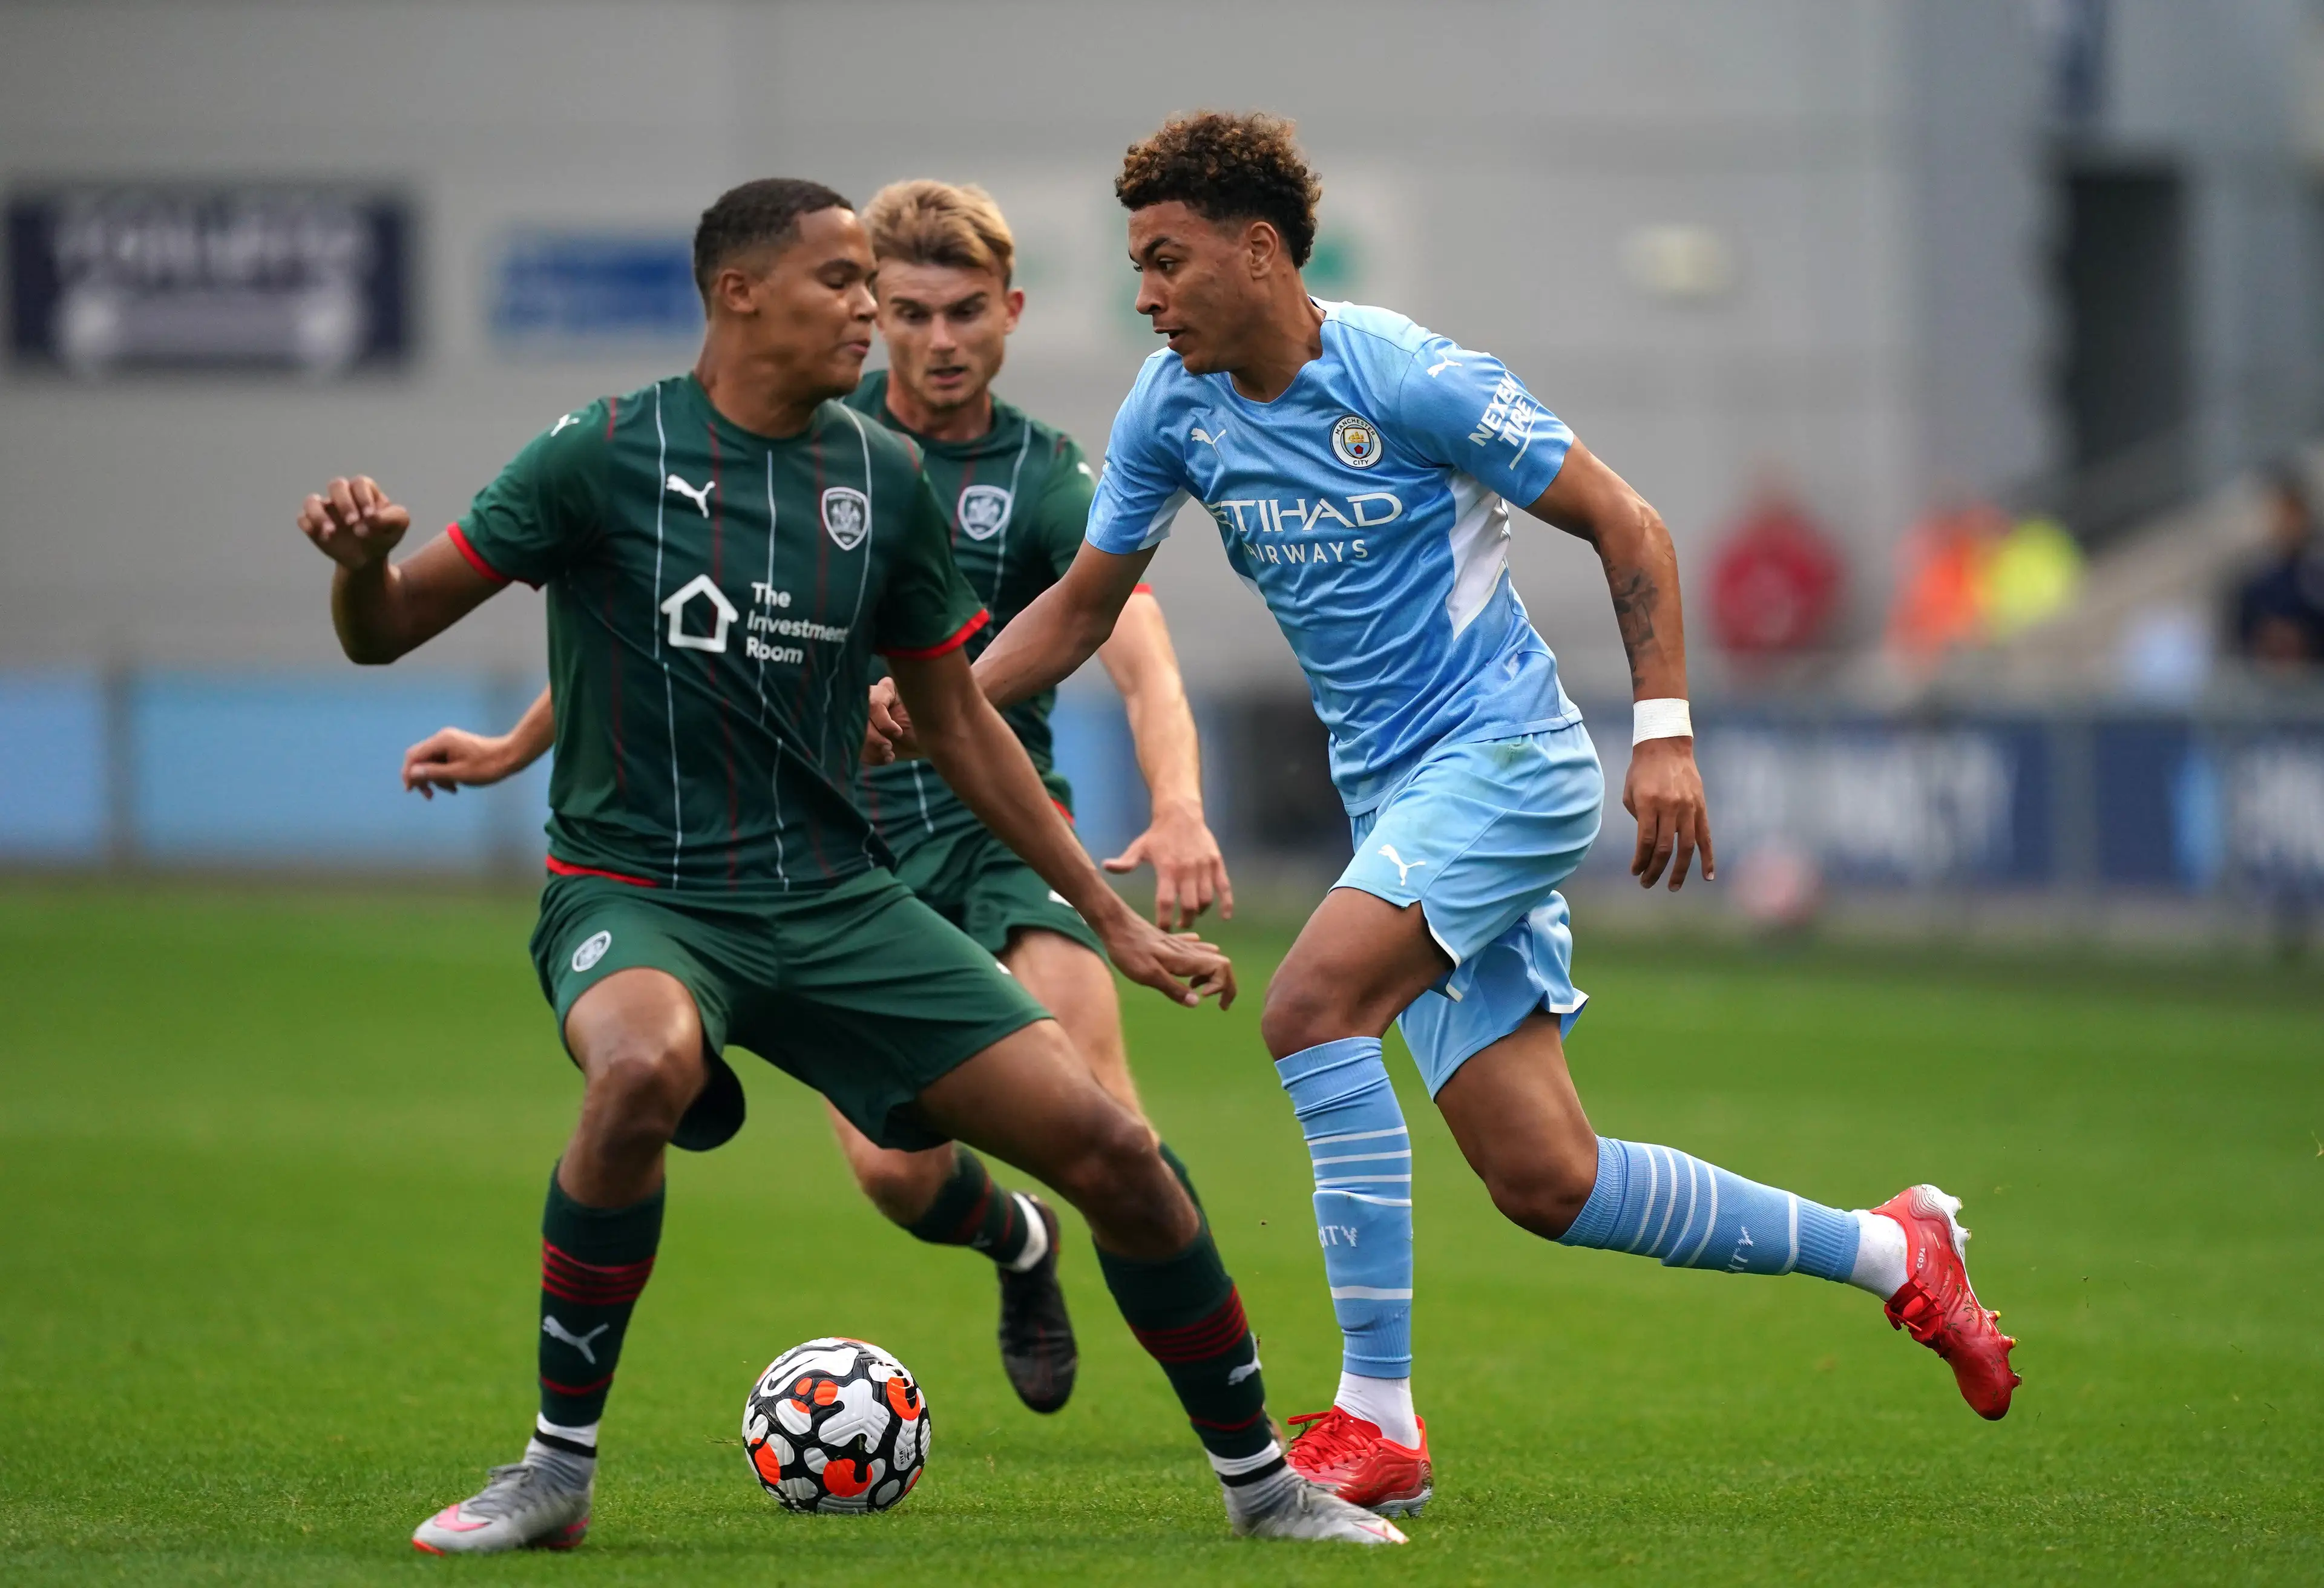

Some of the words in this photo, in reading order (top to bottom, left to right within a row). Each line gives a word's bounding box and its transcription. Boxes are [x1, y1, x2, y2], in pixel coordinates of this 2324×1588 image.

[1468, 371, 1517, 447] NEXEN
[1498, 395, 1532, 447] TIRE
[1335, 418, 1375, 435] MANCHESTER
[1243, 539, 1368, 565] AIRWAYS
[750, 581, 792, 608] The
[746, 636, 804, 664] Room
[1727, 1225, 1753, 1271] ITY
[1917, 1247, 1926, 1268] COPA
